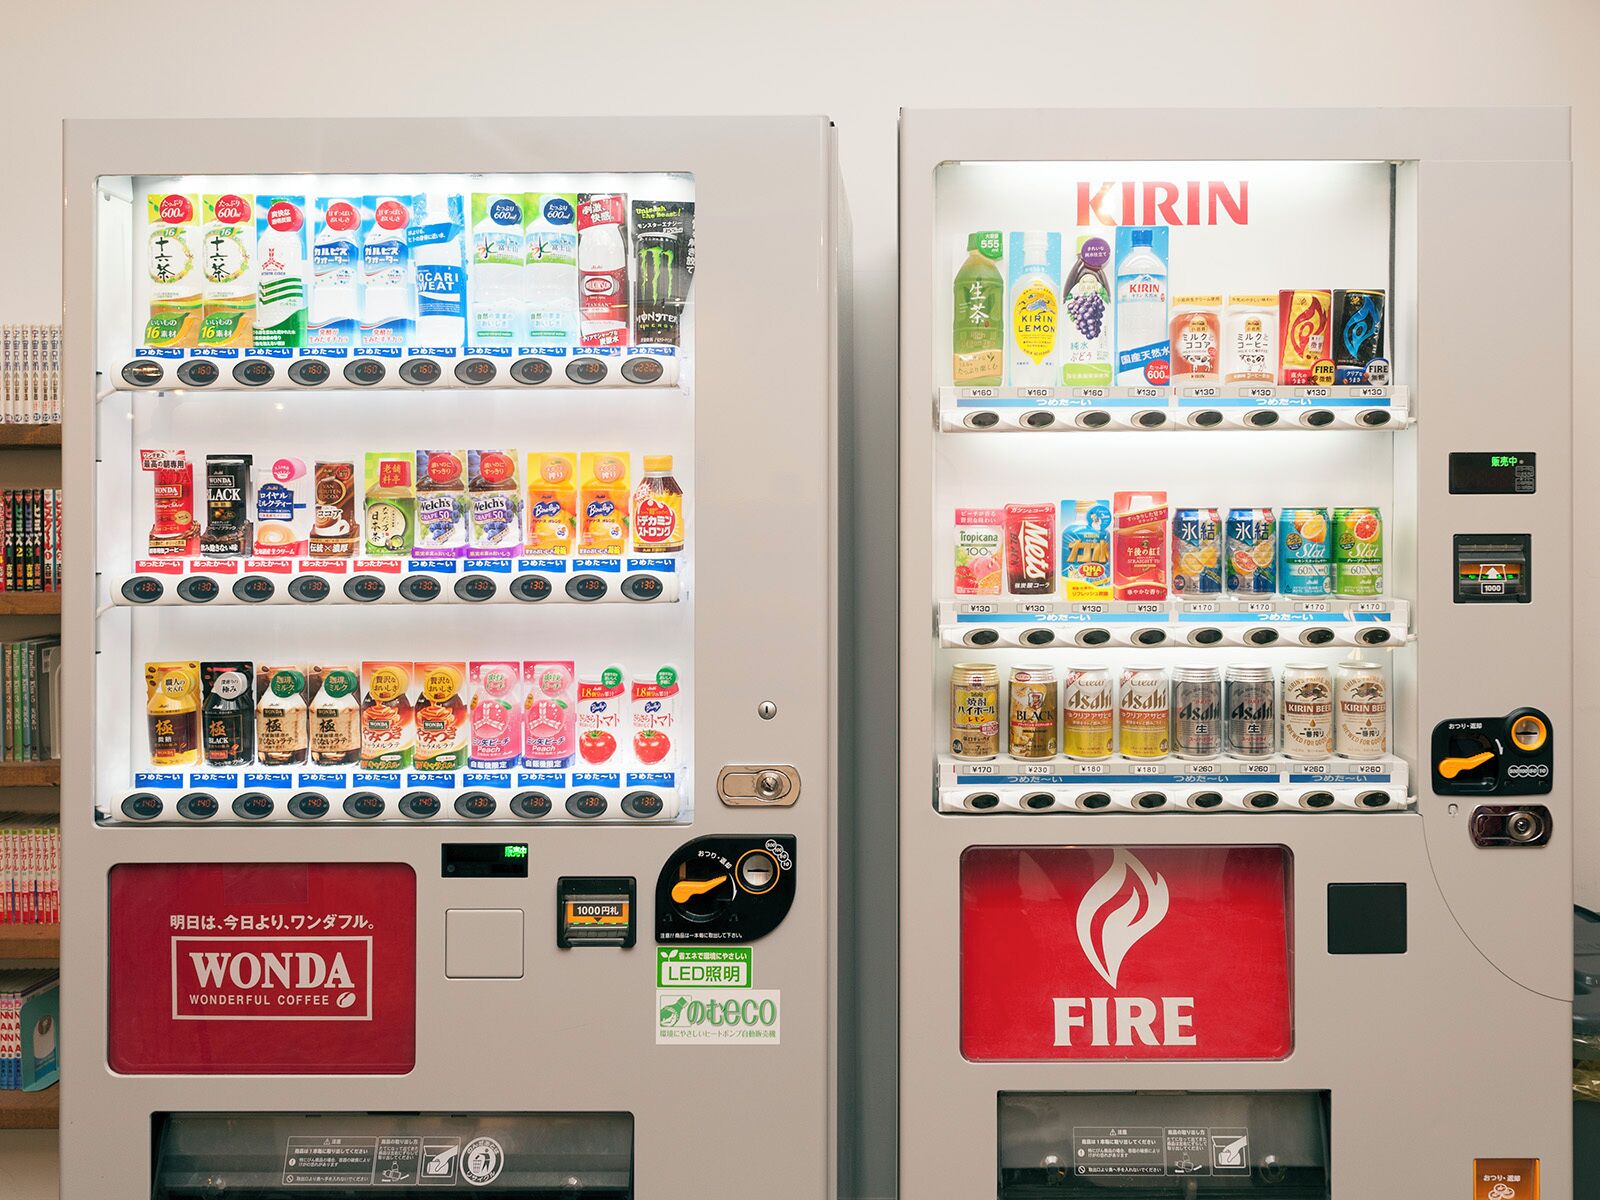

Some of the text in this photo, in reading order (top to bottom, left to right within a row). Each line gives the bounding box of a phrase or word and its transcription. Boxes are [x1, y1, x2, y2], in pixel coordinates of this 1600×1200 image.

[1076, 181, 1249, 226] KIRIN
[980, 240, 1000, 248] 555
[314, 247, 349, 256] カルピス
[365, 247, 400, 256] カルピス
[155, 236, 175, 282] 十六茶
[210, 236, 230, 282] 十六茶
[1129, 284, 1160, 293] KIRIN
[968, 282, 990, 324] 生茶
[1021, 315, 1053, 323] KIRIN
[1182, 333, 1214, 341] ミルクと
[1185, 341, 1211, 349] ココア
[1120, 346, 1170, 365] 国産天然水
[1315, 365, 1334, 374] FIRE
[1369, 365, 1389, 373] FIRE
[1194, 388, 1215, 396] ¥130
[1306, 388, 1326, 396] ¥130
[1362, 388, 1382, 396] ¥130
[1491, 456, 1518, 467] 販売中
[208, 488, 241, 501] LACK
[318, 508, 342, 518] ココア
[492, 510, 504, 519] 50
[637, 515, 672, 526] ドデカミン
[637, 527, 671, 537] ストロング
[959, 531, 998, 543] Tropicana
[1181, 523, 1216, 541] 氷結
[1235, 523, 1270, 541] 氷結
[1024, 520, 1049, 580] Mets
[1484, 584, 1502, 593] 1000
[1069, 688, 1112, 709] Asahi
[1122, 689, 1167, 709] Asahi
[958, 706, 995, 715] ハイボール
[1179, 703, 1219, 721] Asahi
[1231, 703, 1273, 721] Asahi
[1288, 703, 1315, 713] KIRIN
[1344, 703, 1370, 712] KIRIN
[1016, 710, 1053, 721] BLACK
[155, 719, 175, 736] 極
[209, 720, 227, 737] 極
[319, 719, 336, 733] 極
[1195, 724, 1208, 734] 生
[1247, 724, 1261, 734] 生
[504, 845, 528, 859] 販売中
[577, 905, 620, 917] 1000円札
[170, 914, 375, 930] 明日は、今日より、ワンダフル。
[678, 952, 748, 961] 省エネで環境にやさしい
[189, 951, 355, 989] WONDA
[668, 965, 741, 983] LED照明
[189, 994, 329, 1006] WONDERFUL COFFEE
[686, 998, 777, 1026] のむeco
[1052, 995, 1197, 1047] FIRE
